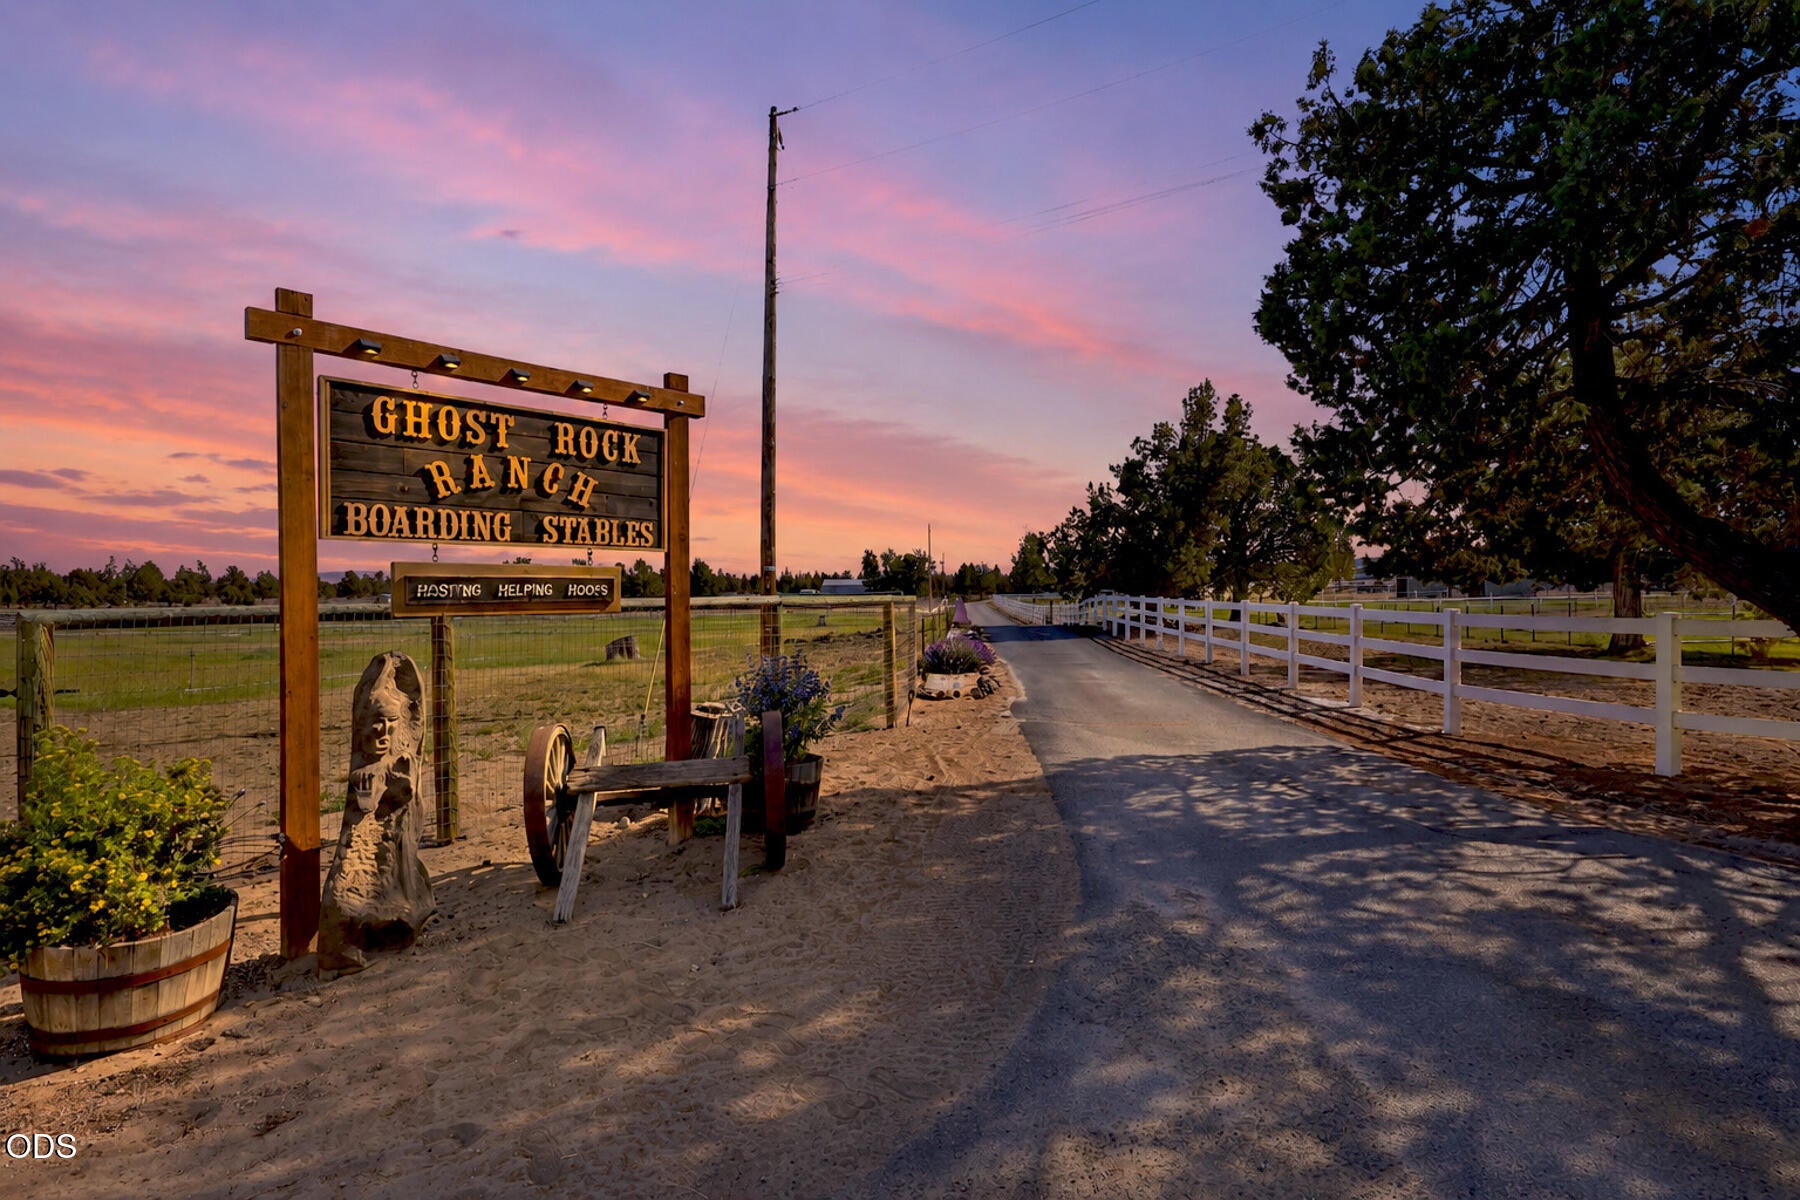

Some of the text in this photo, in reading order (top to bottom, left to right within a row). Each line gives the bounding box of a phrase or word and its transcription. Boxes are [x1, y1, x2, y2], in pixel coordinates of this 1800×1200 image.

[371, 395, 641, 464] GHOST ROCK
[425, 454, 598, 509] RANCH
[343, 502, 654, 547] BOARDING STABLES
[498, 583, 553, 597] HELPING
